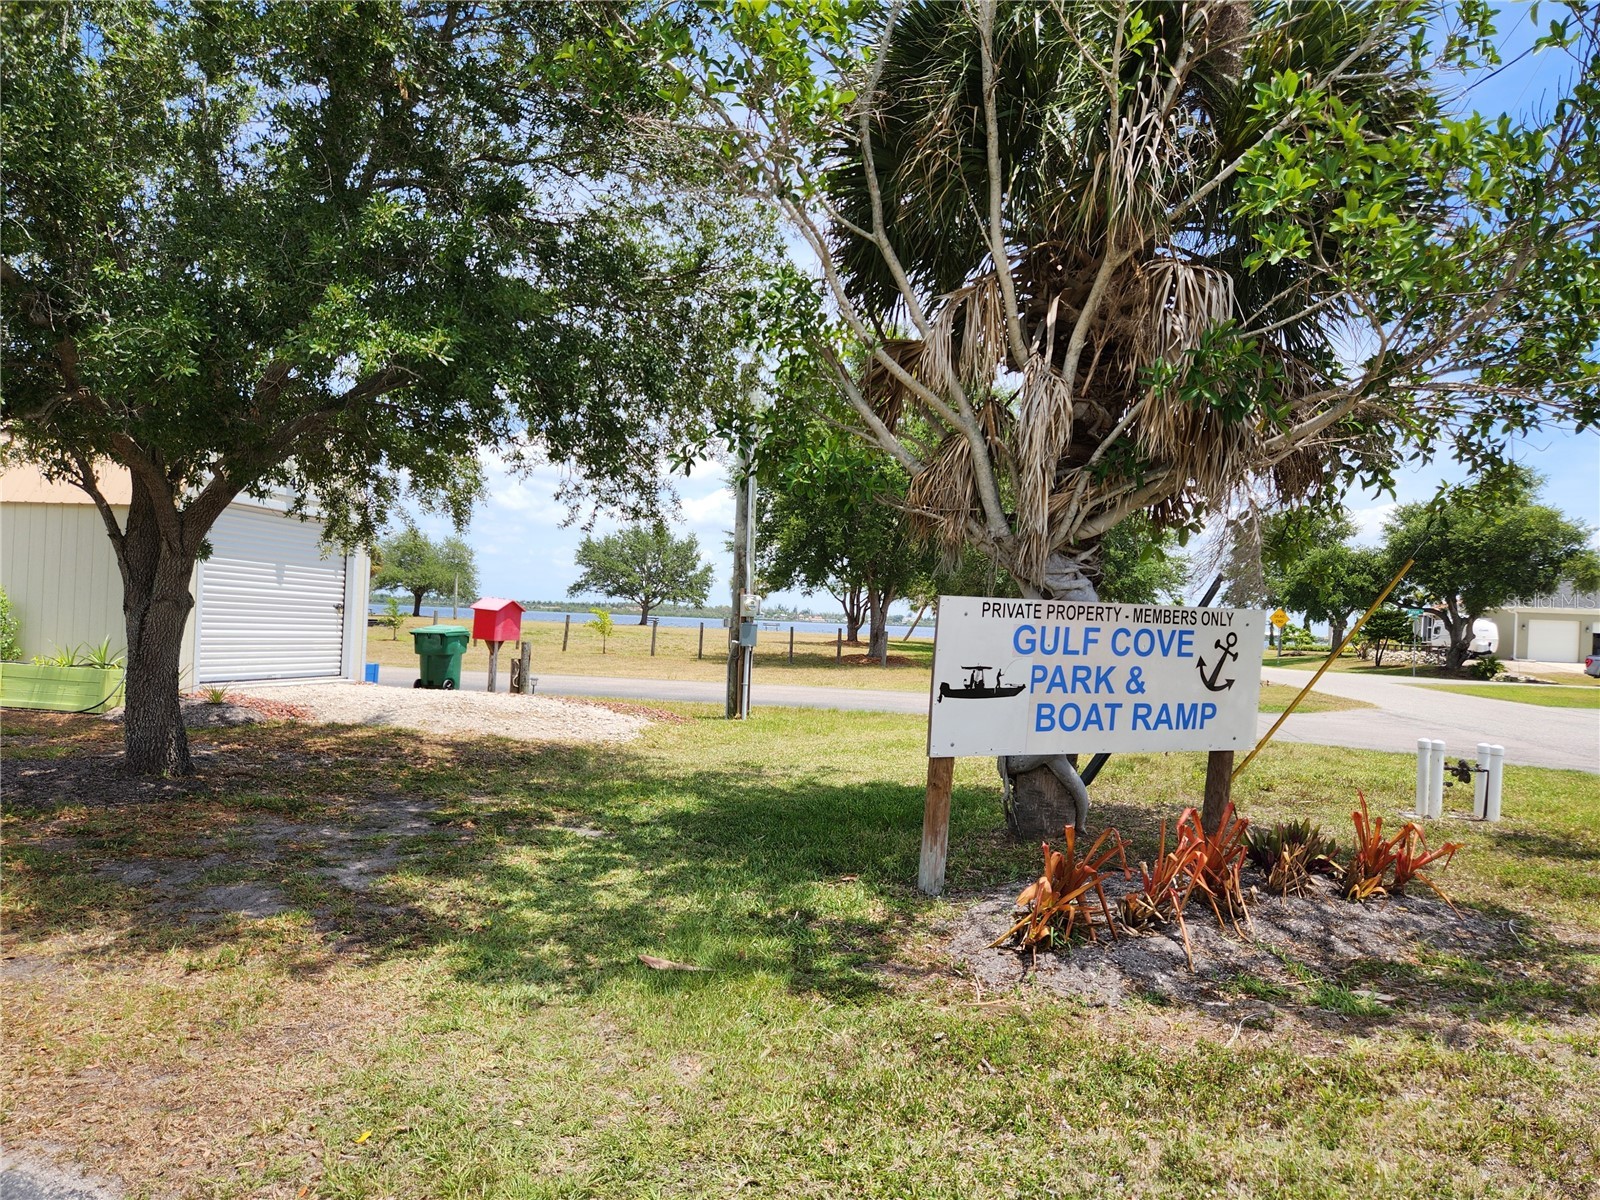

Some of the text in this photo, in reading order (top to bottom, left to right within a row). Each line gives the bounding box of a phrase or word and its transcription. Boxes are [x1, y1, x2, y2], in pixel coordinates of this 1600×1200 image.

[982, 602, 1042, 619] PRIVATE
[1046, 604, 1122, 622] PROPERTY
[1133, 608, 1197, 625] MEMBERS
[1201, 611, 1234, 627] ONLY
[1013, 624, 1195, 658] GULF COVE
[1030, 664, 1146, 695] PARK &
[1035, 702, 1217, 732] BOAT RAMP
